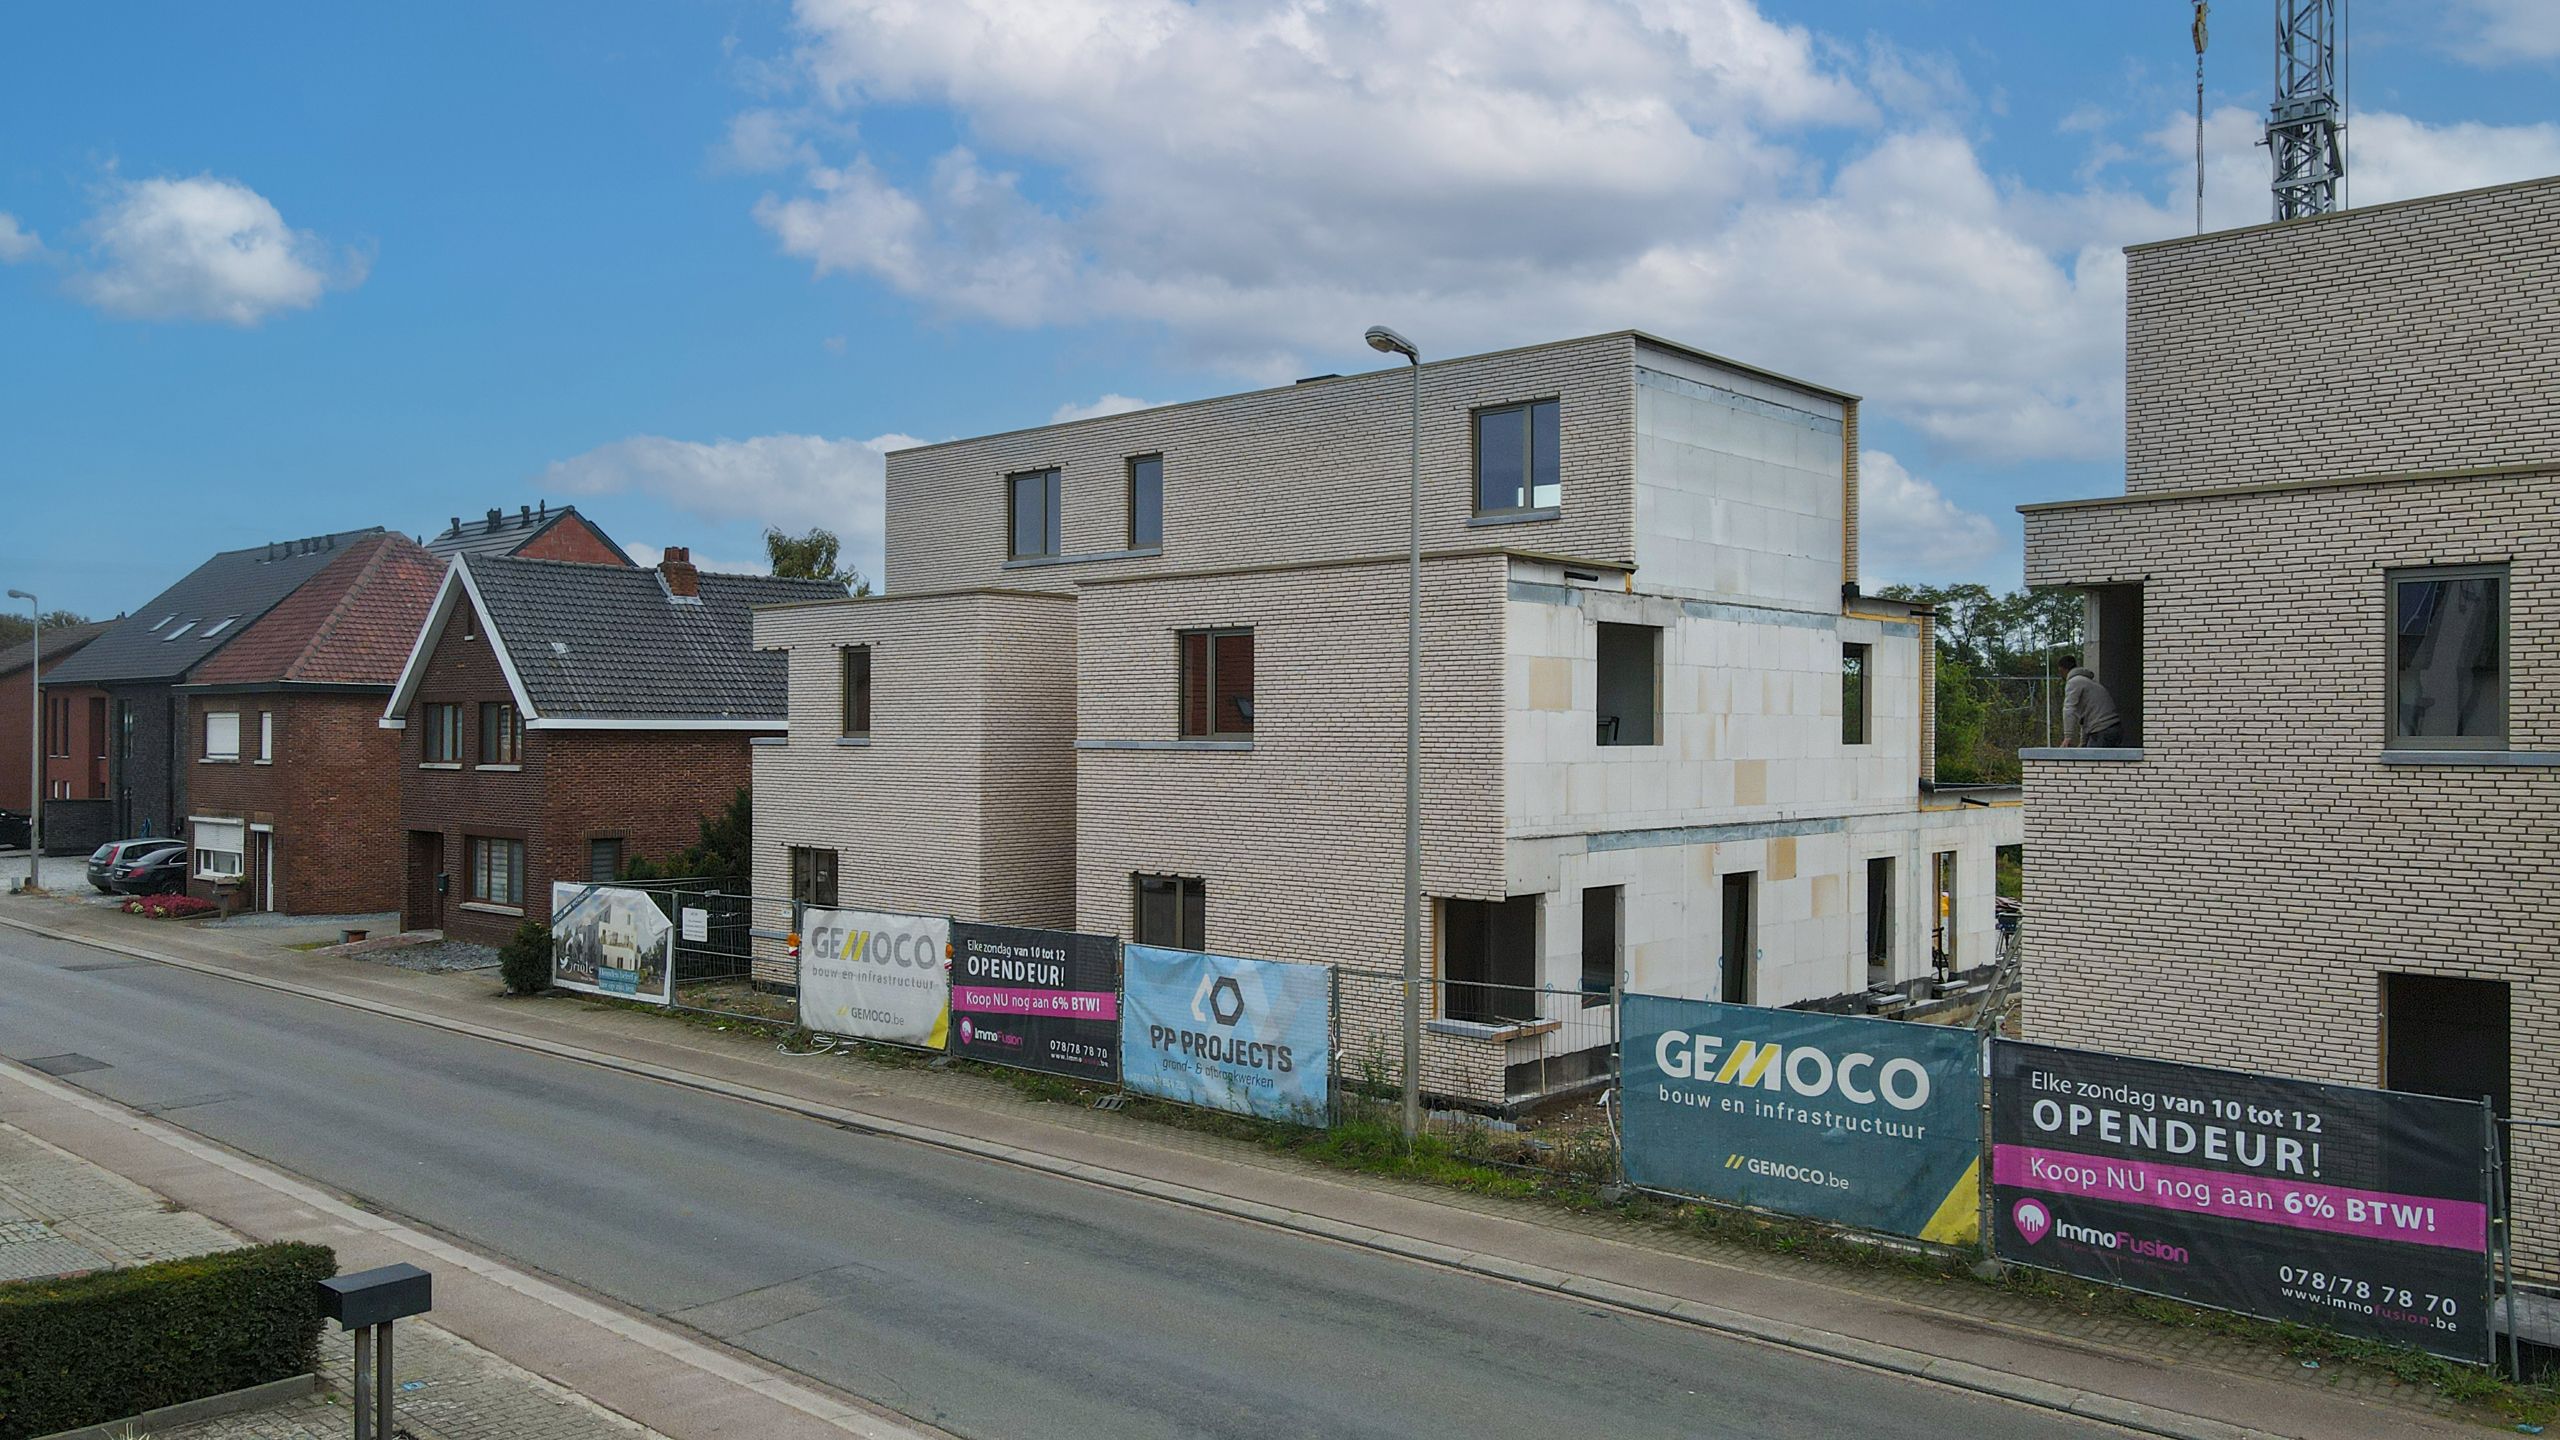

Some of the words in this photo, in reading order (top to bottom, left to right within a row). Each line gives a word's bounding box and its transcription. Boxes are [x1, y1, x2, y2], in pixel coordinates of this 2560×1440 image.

[811, 926, 936, 969] GEMOCO
[967, 940, 983, 951] Elke
[983, 943, 1012, 958] zondag
[1014, 947, 1028, 957] van
[1031, 947, 1040, 958] 10
[1042, 949, 1054, 960] tot
[1056, 950, 1066, 962] 12
[813, 967, 837, 979] bouw
[842, 971, 854, 980] en
[858, 970, 933, 989] infrastructuur
[967, 955, 1065, 987] OPENDEUR!
[851, 1007, 905, 1026] GEMOCO.be
[966, 991, 991, 1007] Koop
[993, 993, 1008, 1007] NU
[1012, 996, 1030, 1010] nog
[1032, 998, 1049, 1009] aan
[1052, 996, 1069, 1010] 6%
[1072, 997, 1100, 1012] BTW!
[1050, 1039, 1081, 1055] 078/78
[1083, 1045, 1095, 1057] 78
[1096, 1047, 1108, 1059] 70
[1150, 1024, 1177, 1051] PP
[1180, 1030, 1293, 1073] PROJECTS
[1655, 1030, 1931, 1111] GEMOCO
[1163, 1057, 1192, 1073] grond-
[1205, 1064, 1274, 1089] afbraakwerken
[1659, 1084, 1712, 1109] bouw
[1721, 1097, 1745, 1114] en
[1755, 1099, 1926, 1140] infrastructuur
[2031, 1070, 2072, 1094] Elke
[2076, 1082, 2156, 1112] zondag
[2162, 1095, 2205, 1115] van
[2213, 1099, 2242, 1121] 10
[2247, 1104, 2284, 1128] tot
[2292, 1111, 2322, 1133] 12
[2032, 1099, 2322, 1178] OPENDEUR!
[1748, 1158, 1850, 1190] GEMOCO.be
[2030, 1157, 2097, 1190] Koop
[2107, 1166, 2145, 1193] NU
[2157, 1178, 2210, 1207] nog
[2221, 1187, 2273, 1210] aan
[2283, 1191, 2335, 1219] 6%
[2346, 1198, 2436, 1232] BTW!
[2056, 1218, 2189, 1265] ImmoFusion
[2279, 1265, 2371, 1300] 078/78
[2381, 1285, 2414, 1308] 78
[2424, 1294, 2457, 1316] 70
[2281, 1286, 2457, 1332] www.immofusion.be
